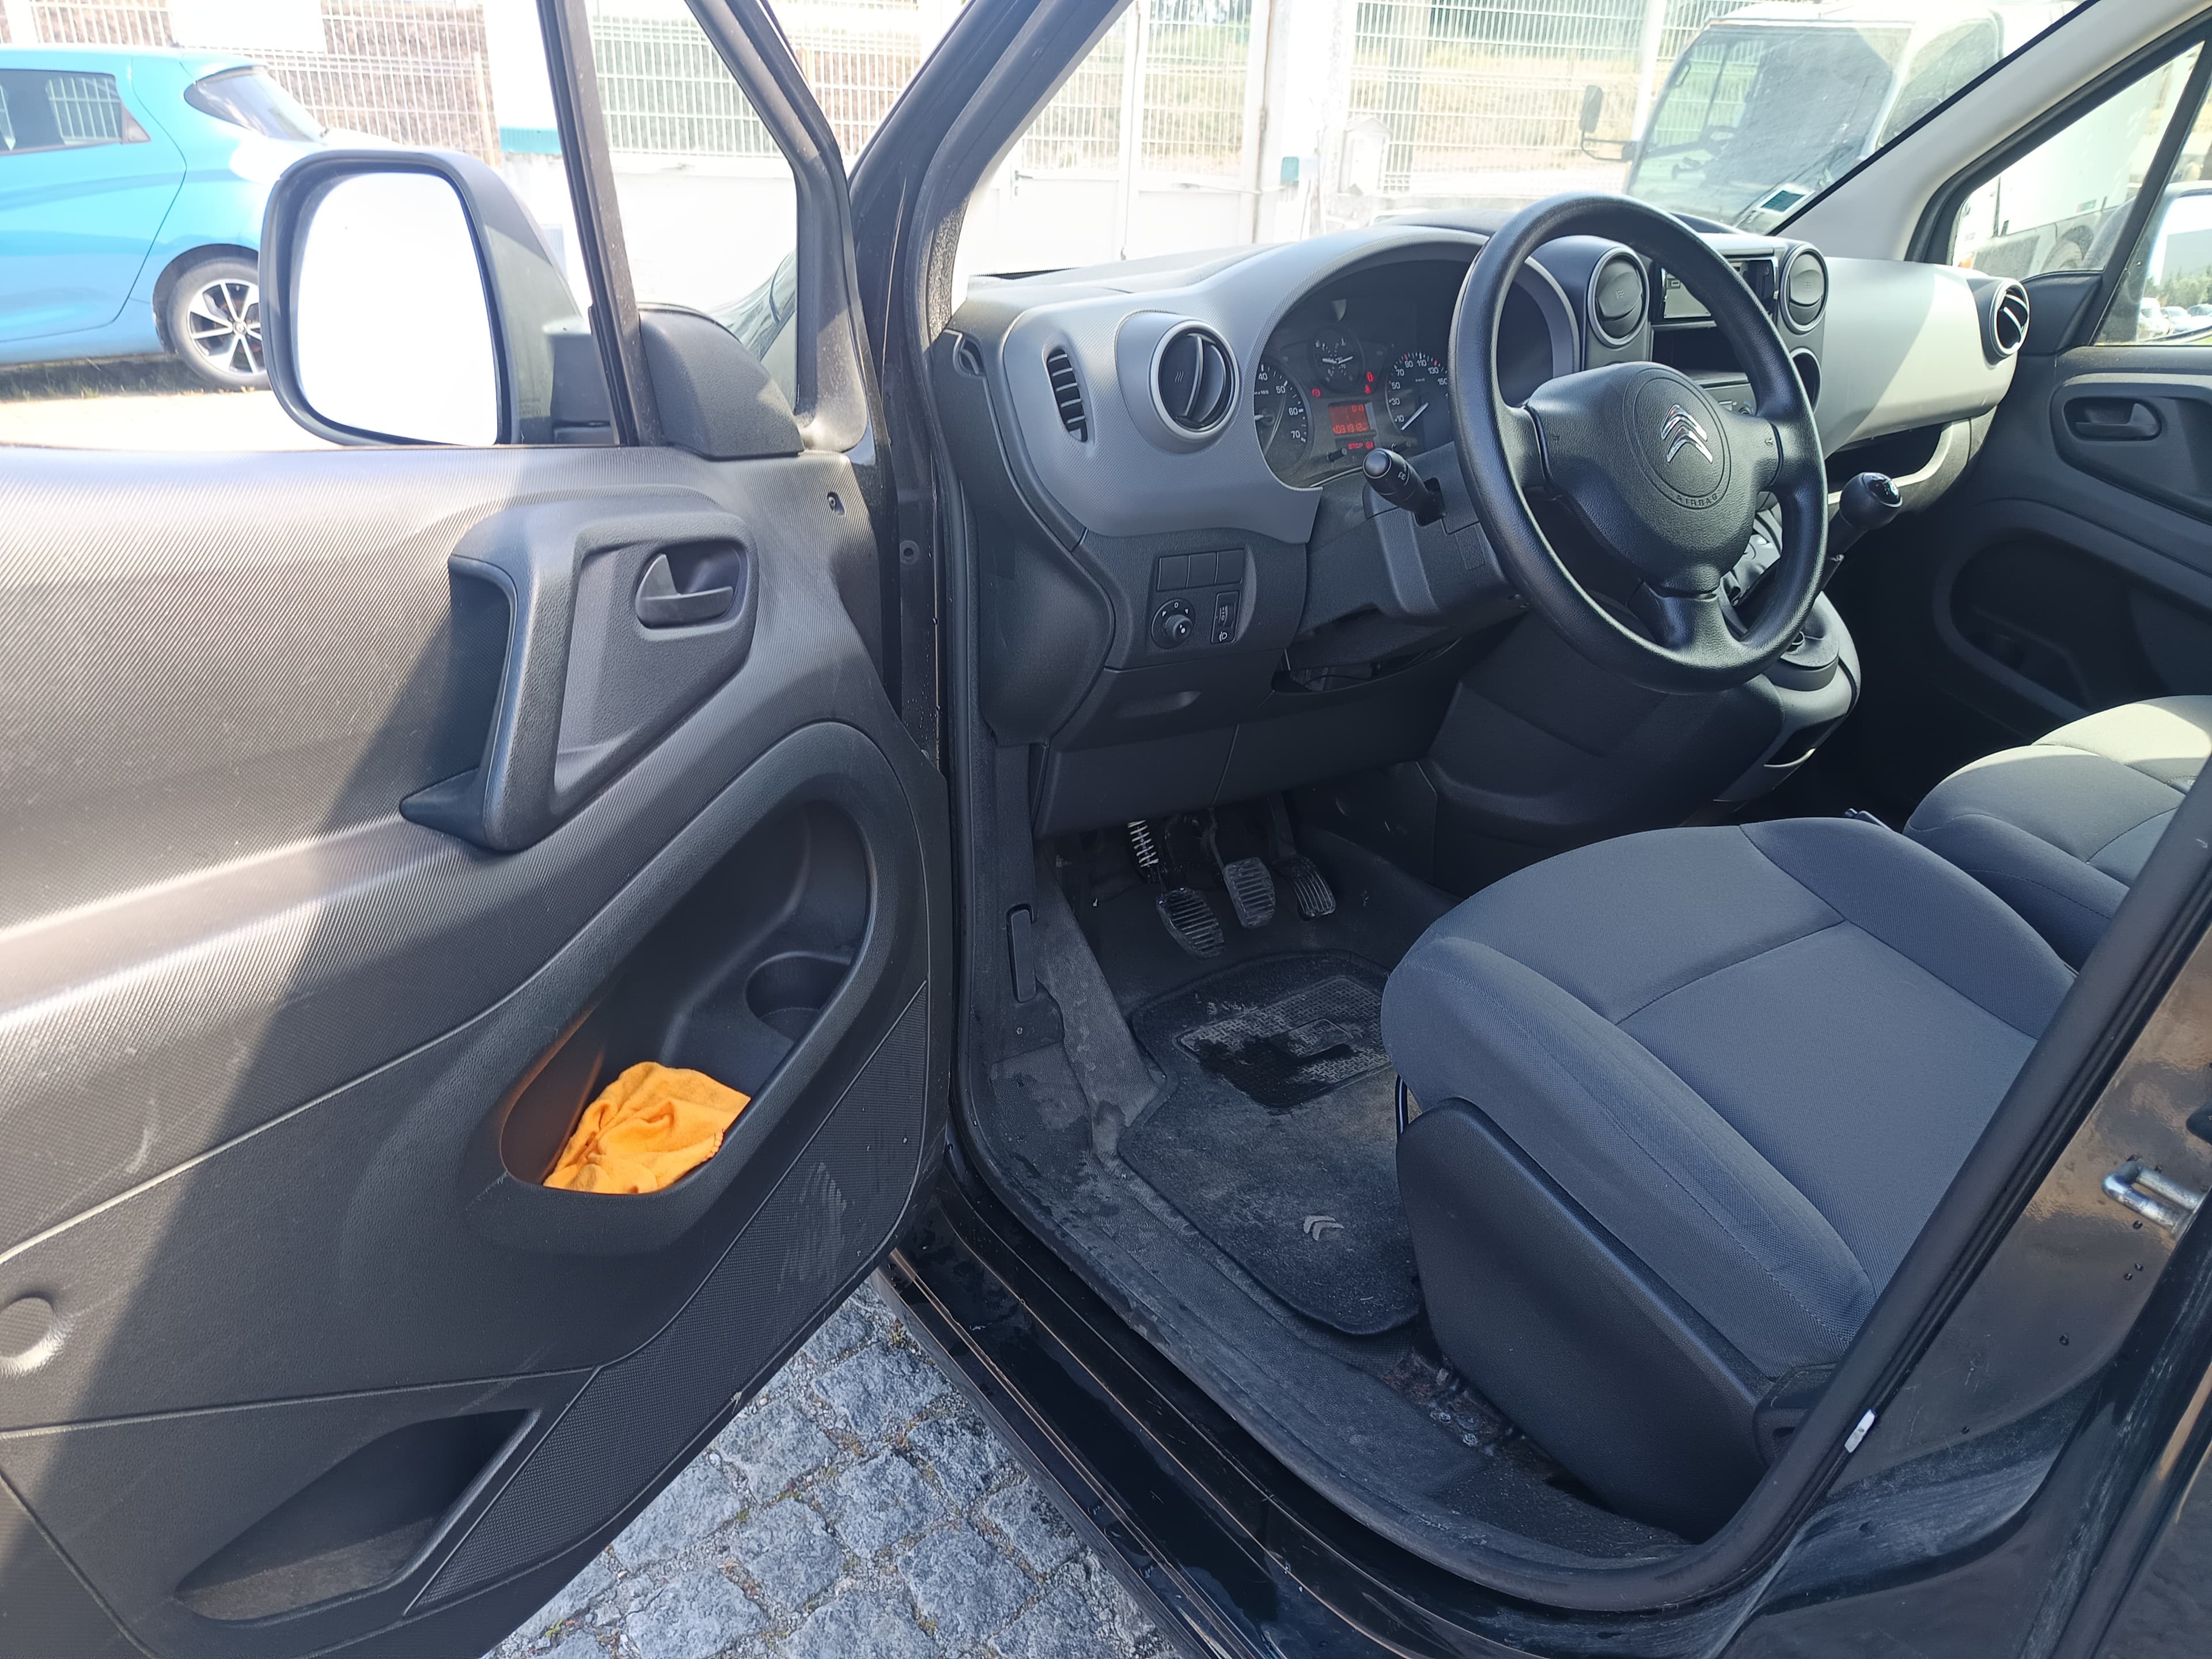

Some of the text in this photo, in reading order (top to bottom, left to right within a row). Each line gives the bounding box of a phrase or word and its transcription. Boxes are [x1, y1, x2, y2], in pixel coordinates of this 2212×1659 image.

[1258, 373, 1268, 381] 40
[1276, 385, 1286, 393] 50
[1391, 381, 1400, 389] 50
[1391, 397, 1400, 406] 30
[1289, 407, 1298, 415] 60
[1291, 430, 1301, 438] 70
[1677, 493, 1717, 506] AIRBAG
